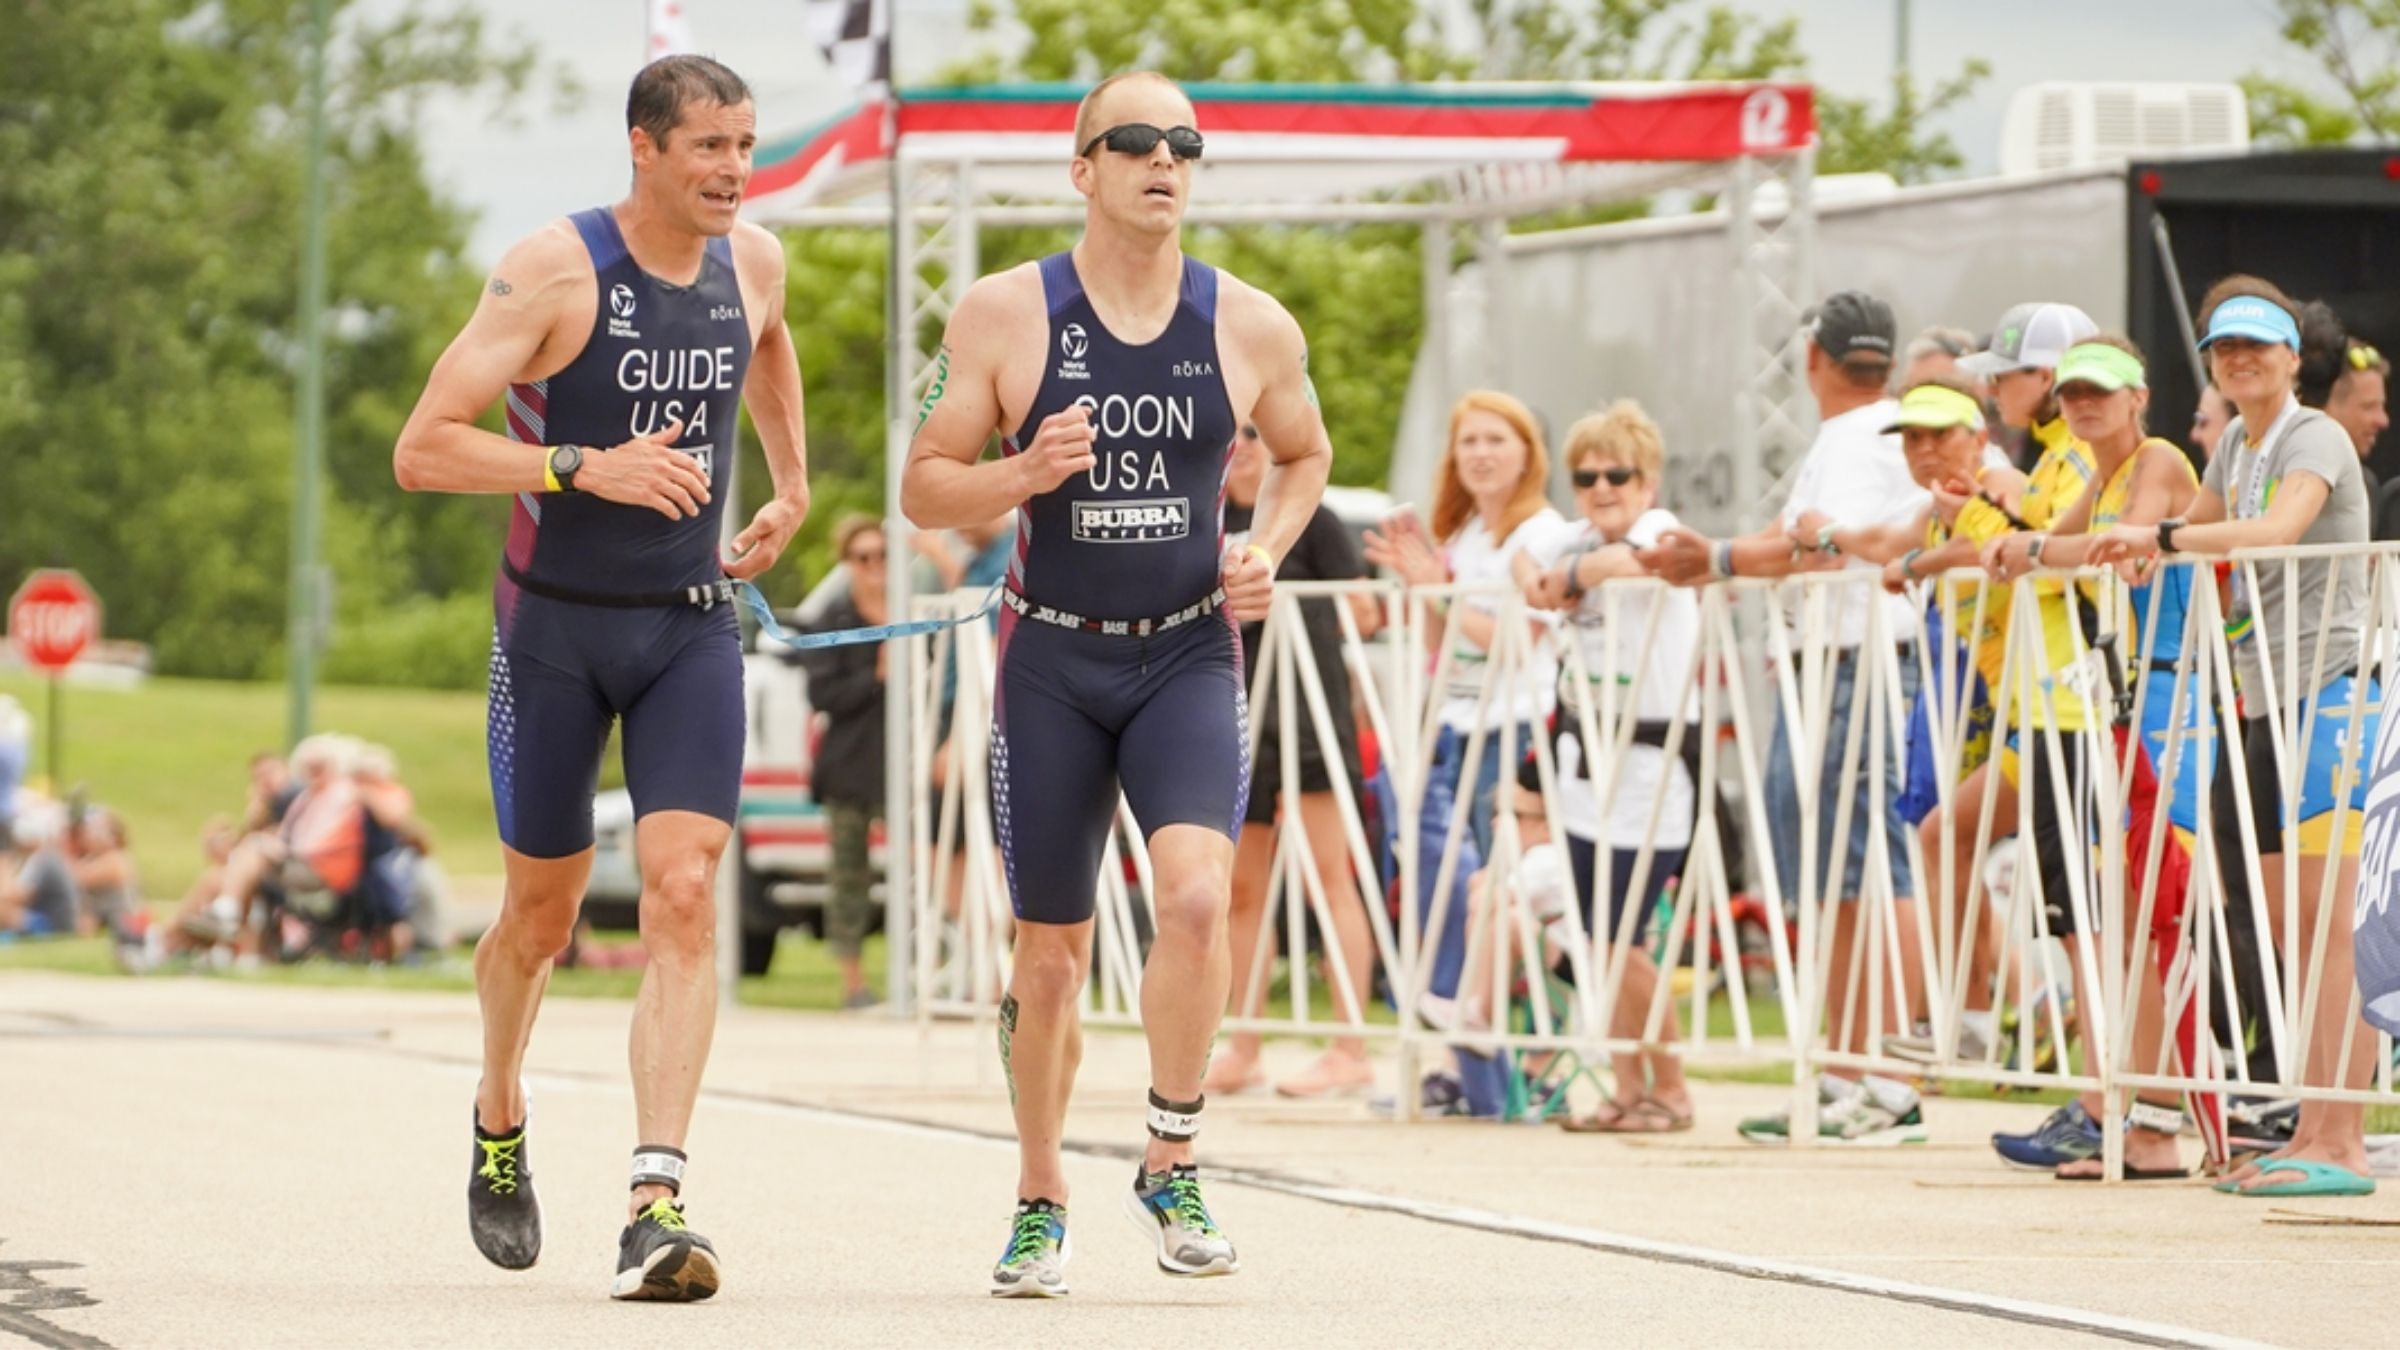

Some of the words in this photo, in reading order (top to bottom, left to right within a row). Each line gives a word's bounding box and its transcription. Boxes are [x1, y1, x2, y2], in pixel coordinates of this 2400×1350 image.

[617, 346, 734, 392] GUIDE
[630, 400, 707, 438] USA
[1090, 450, 1170, 492] USA
[1080, 506, 1185, 529] BUBBA
[17, 602, 98, 646] STOP
[1102, 620, 1129, 635] BASE
